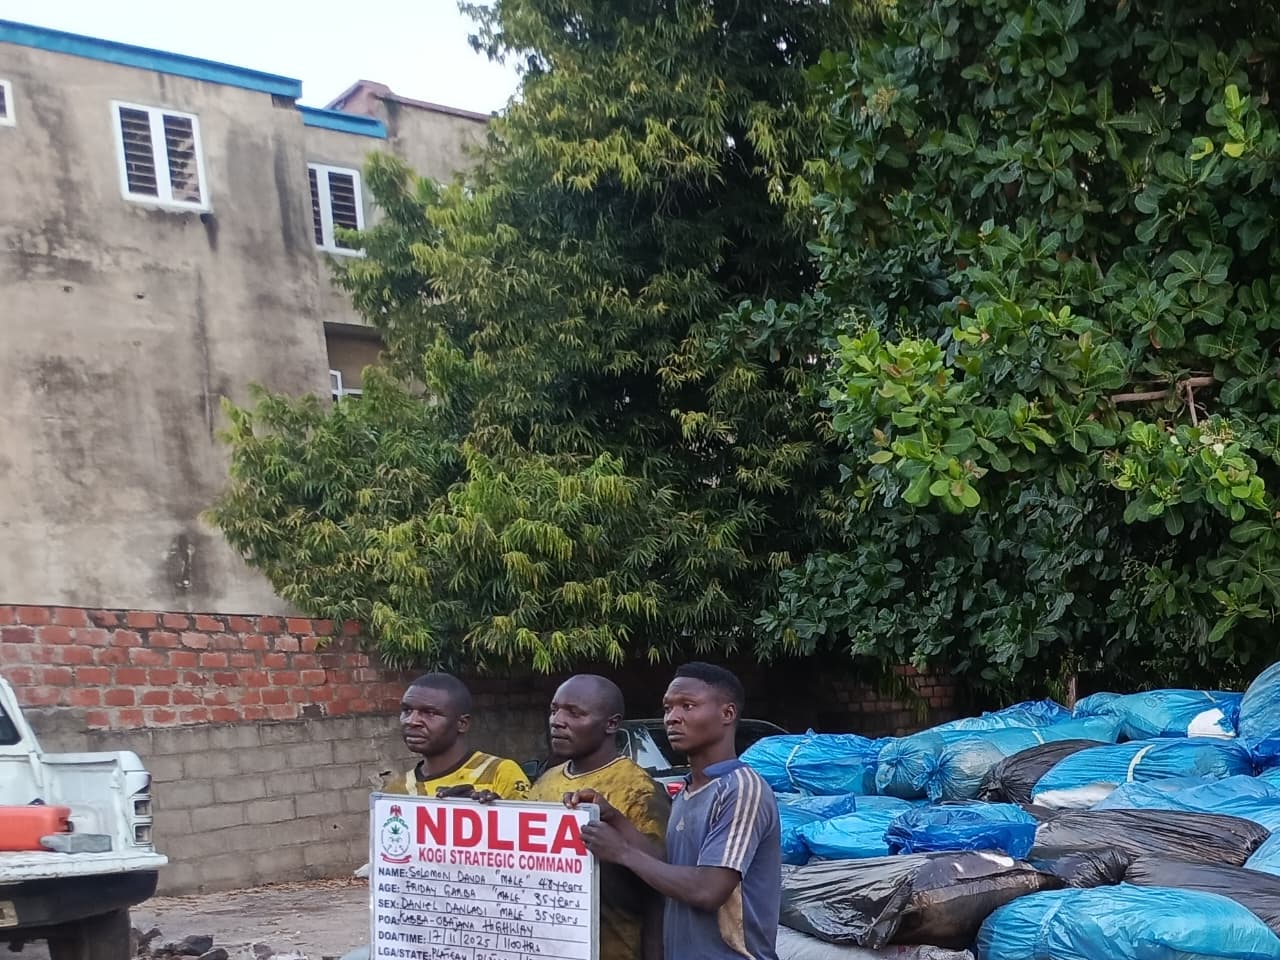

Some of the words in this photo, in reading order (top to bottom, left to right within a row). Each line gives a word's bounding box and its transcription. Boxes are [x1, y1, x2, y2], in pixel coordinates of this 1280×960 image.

[416, 806, 588, 856] NDLEA
[418, 848, 446, 863] KOGI
[450, 850, 514, 869] STRATEGIC
[519, 855, 582, 873] COMMAND
[378, 867, 408, 878] NAME:
[378, 883, 401, 893] AGE:
[443, 884, 476, 898] GARBA
[378, 899, 400, 909] SEX:
[378, 915, 401, 926] POA:
[378, 931, 426, 945] DOA/TIME:
[378, 947, 432, 960] LGA/STATE:
